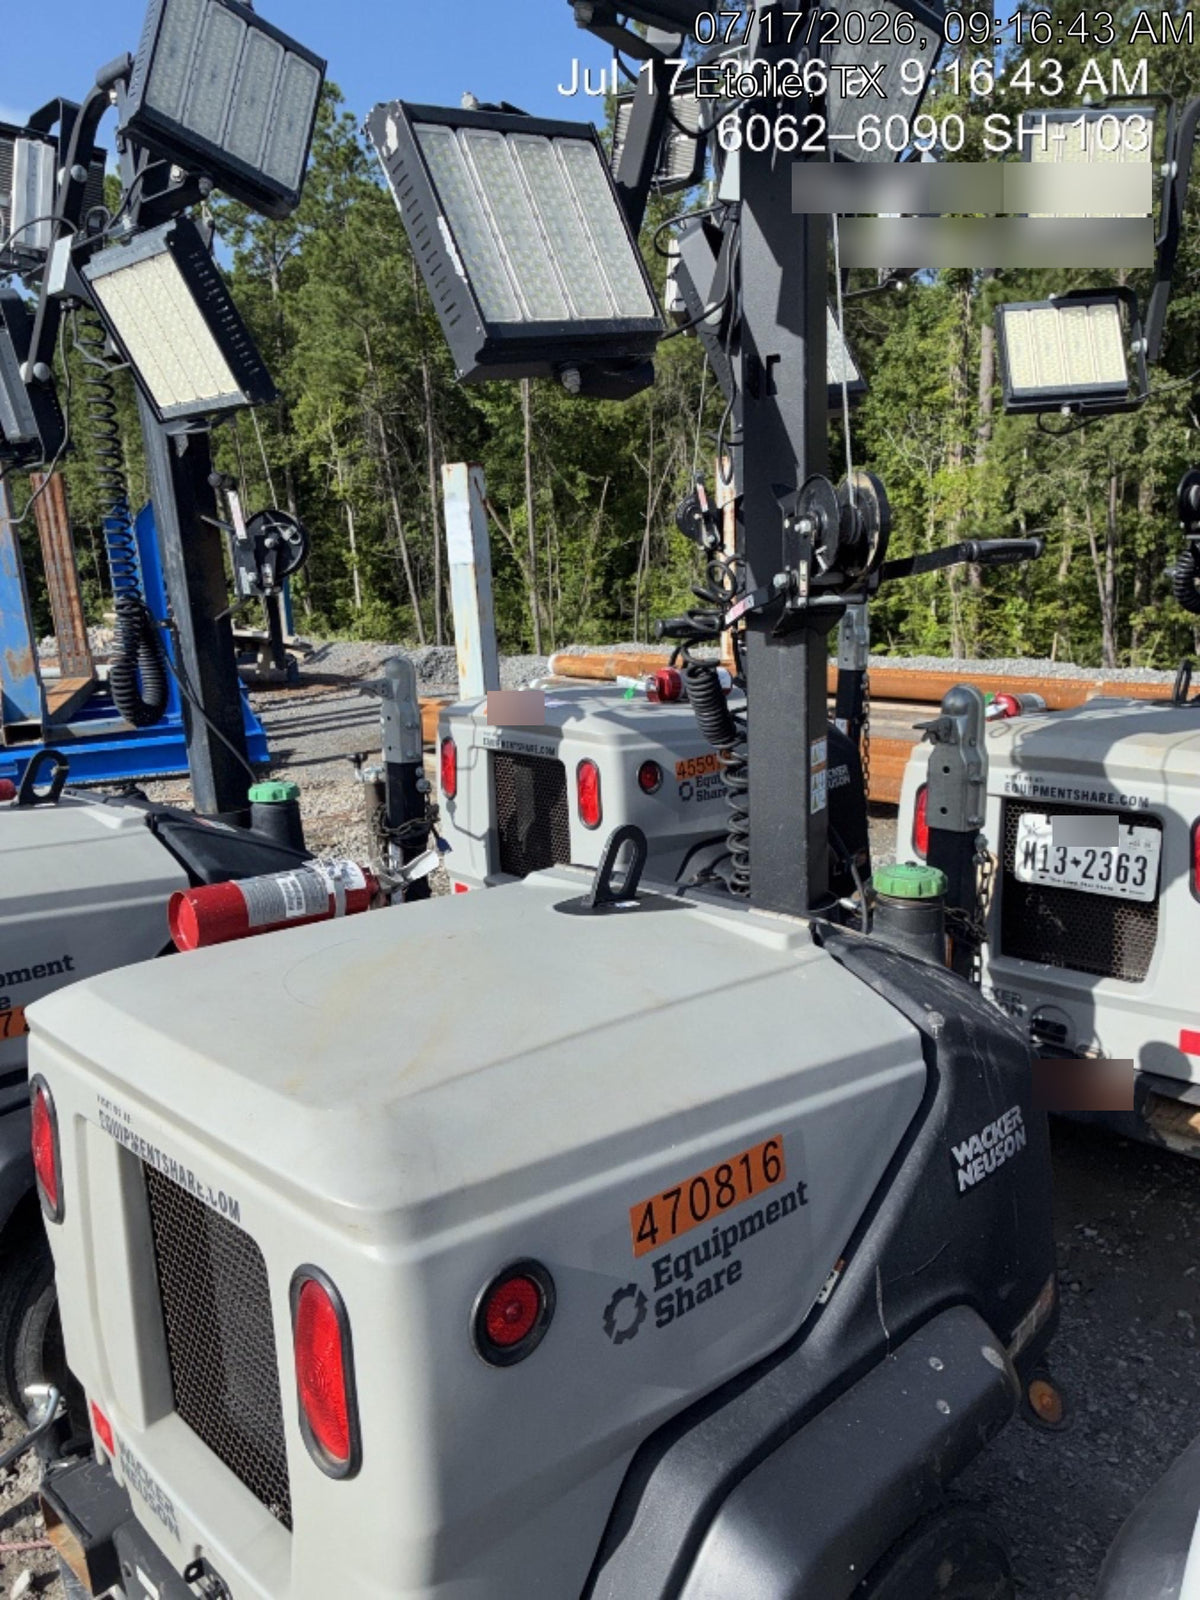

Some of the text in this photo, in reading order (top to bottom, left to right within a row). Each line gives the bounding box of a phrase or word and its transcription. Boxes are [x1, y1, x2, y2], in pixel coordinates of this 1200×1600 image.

[1004, 782, 1149, 808] EQUIPMENTSHARE.COM
[951, 1105, 1024, 1167] WACKER
[957, 1124, 1027, 1192] NEUSON
[634, 1140, 784, 1246] 470816
[651, 1180, 809, 1293] Equipment
[653, 1258, 744, 1330] Share
